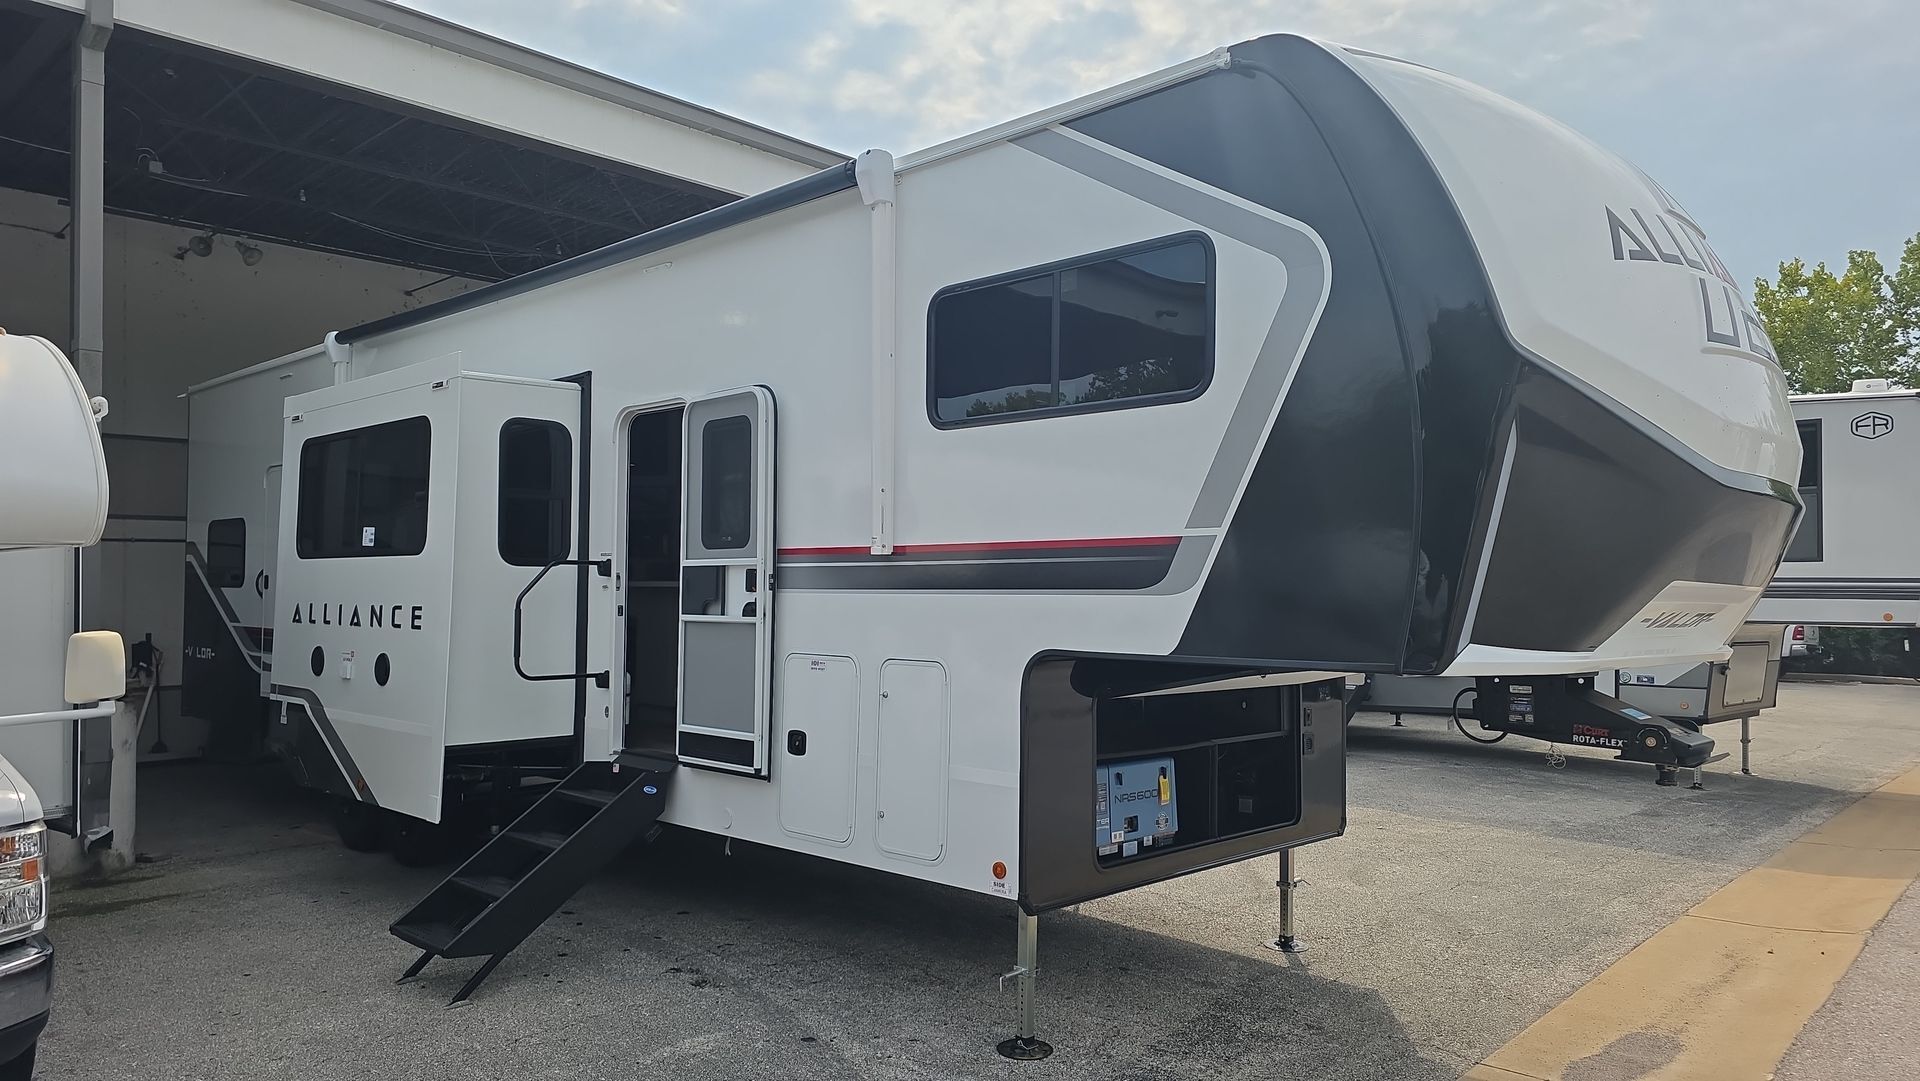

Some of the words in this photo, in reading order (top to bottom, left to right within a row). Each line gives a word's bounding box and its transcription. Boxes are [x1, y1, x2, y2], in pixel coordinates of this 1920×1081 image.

[1854, 414, 1890, 436] FR
[291, 602, 423, 631] ALLIANCE
[1572, 734, 1624, 748] ROTA-FLEX
